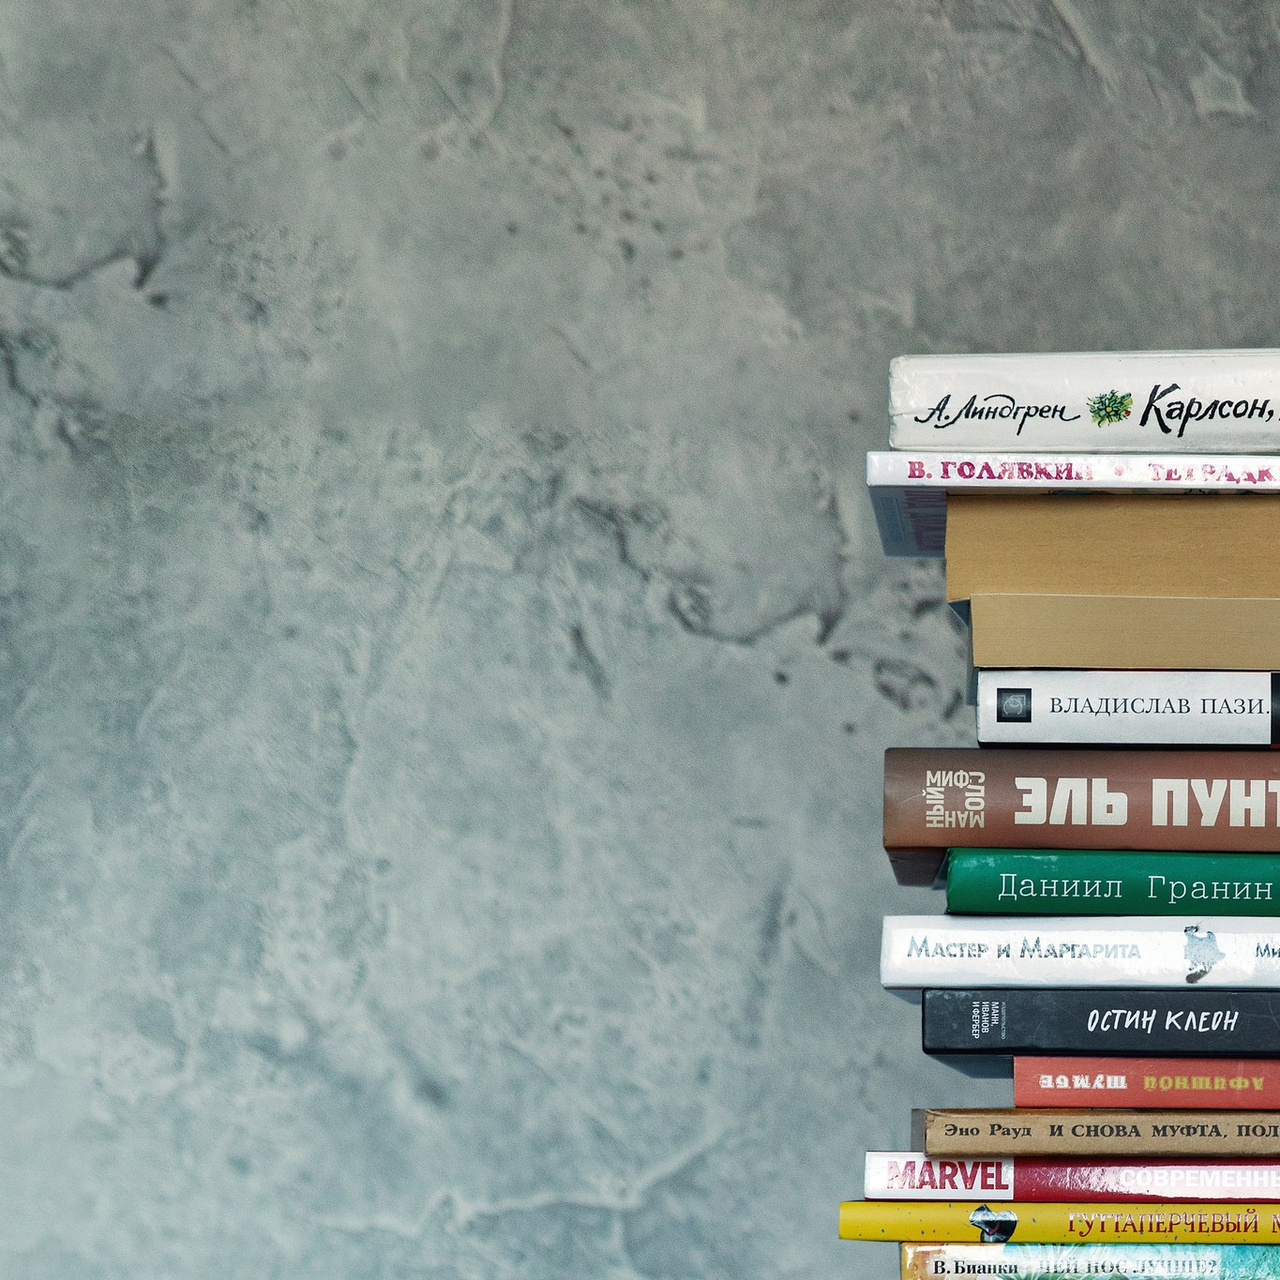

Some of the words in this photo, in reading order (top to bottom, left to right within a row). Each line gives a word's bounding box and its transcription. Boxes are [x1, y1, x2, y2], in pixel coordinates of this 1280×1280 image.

[934, 394, 1081, 437] Линдгрен
[908, 461, 932, 480] В.
[940, 461, 1094, 481] ГОЛЯВКИН
[1050, 697, 1191, 717] ВЛАДИСЛАВ
[1200, 698, 1271, 715] ПАЗИ.
[926, 769, 970, 789] МИФ
[1014, 777, 1129, 825] ЭЛЬ
[998, 873, 1123, 901] Даниил
[1148, 875, 1273, 904] Гранин
[971, 1007, 980, 1039] ФЕРБЕР
[981, 1001, 990, 1034] ИВАНОВ
[1087, 1009, 1156, 1034] ОСТИН
[1165, 1011, 1239, 1032] КЛЕОН
[944, 1123, 980, 1137] Эно
[989, 1123, 1032, 1138] Рауд
[1071, 1124, 1142, 1138] СНОВА
[1151, 1124, 1228, 1140] МУФТА,
[887, 1160, 1010, 1191] MARVEL
[1068, 1211, 1259, 1237] ГУТТАПЕРЧЕВЫЙ
[933, 1260, 950, 1275] В.
[954, 1260, 1018, 1275] Бианки
[1039, 1257, 1078, 1274] ЧЕЙ
[1087, 1260, 1127, 1274] НОС
